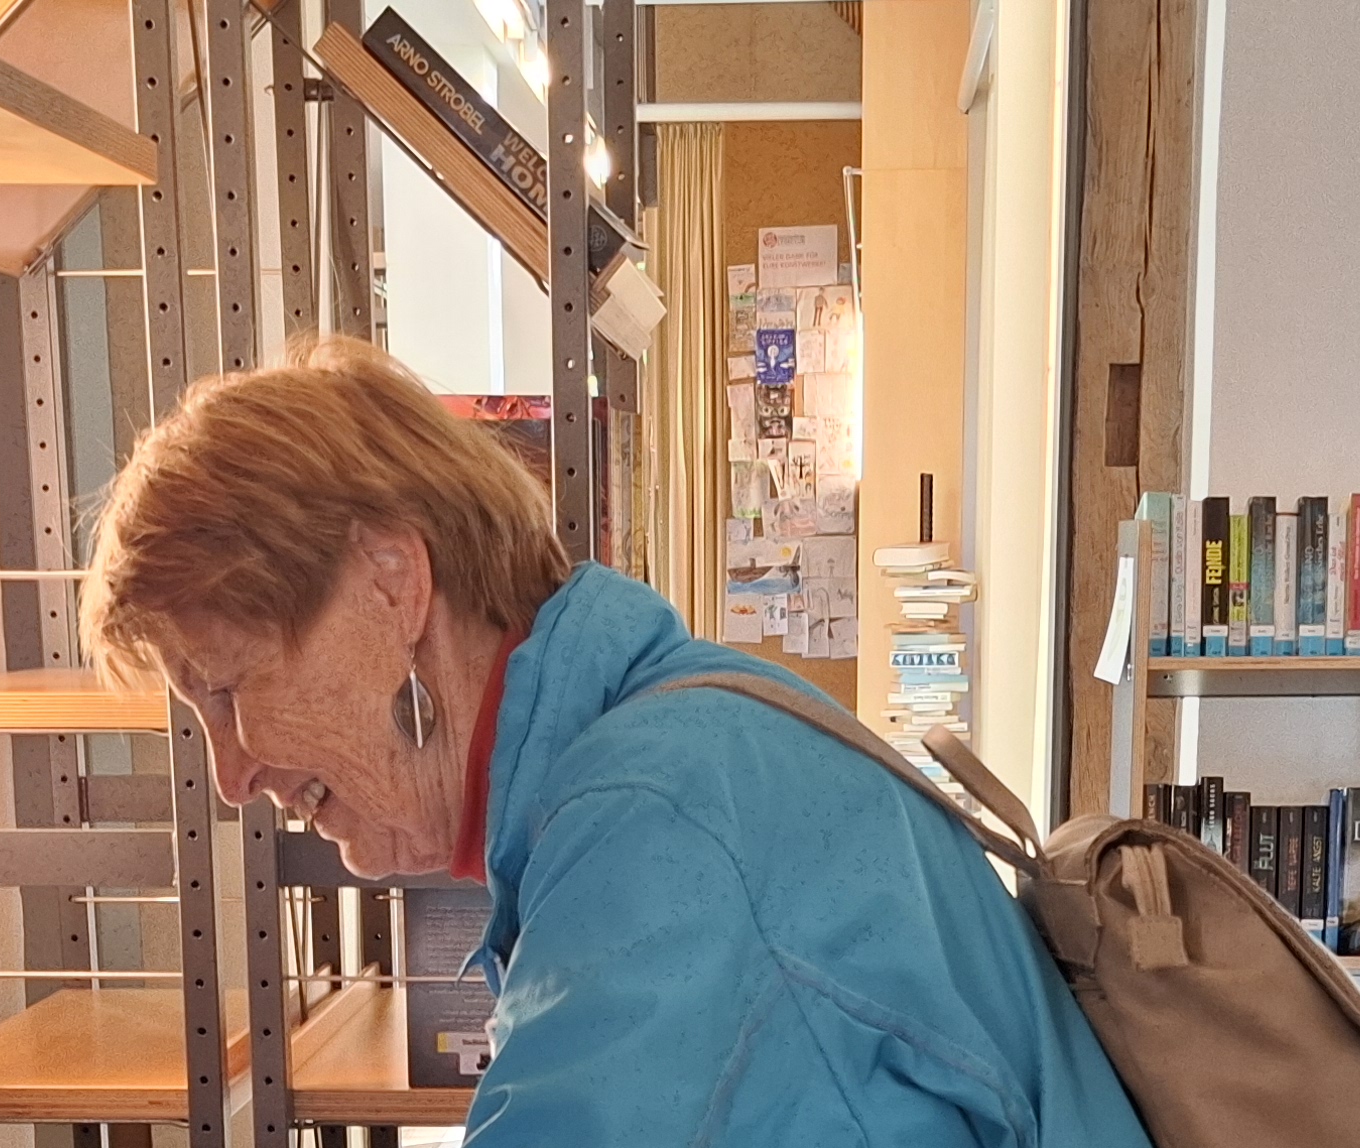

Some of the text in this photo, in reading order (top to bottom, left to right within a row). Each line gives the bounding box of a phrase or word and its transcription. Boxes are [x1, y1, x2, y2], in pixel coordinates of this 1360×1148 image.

[386, 32, 486, 136] ARNO STROBEL
[1205, 539, 1223, 586] FEINDE
[1258, 832, 1274, 871] FLUT
[1312, 866, 1322, 894] KALTE
